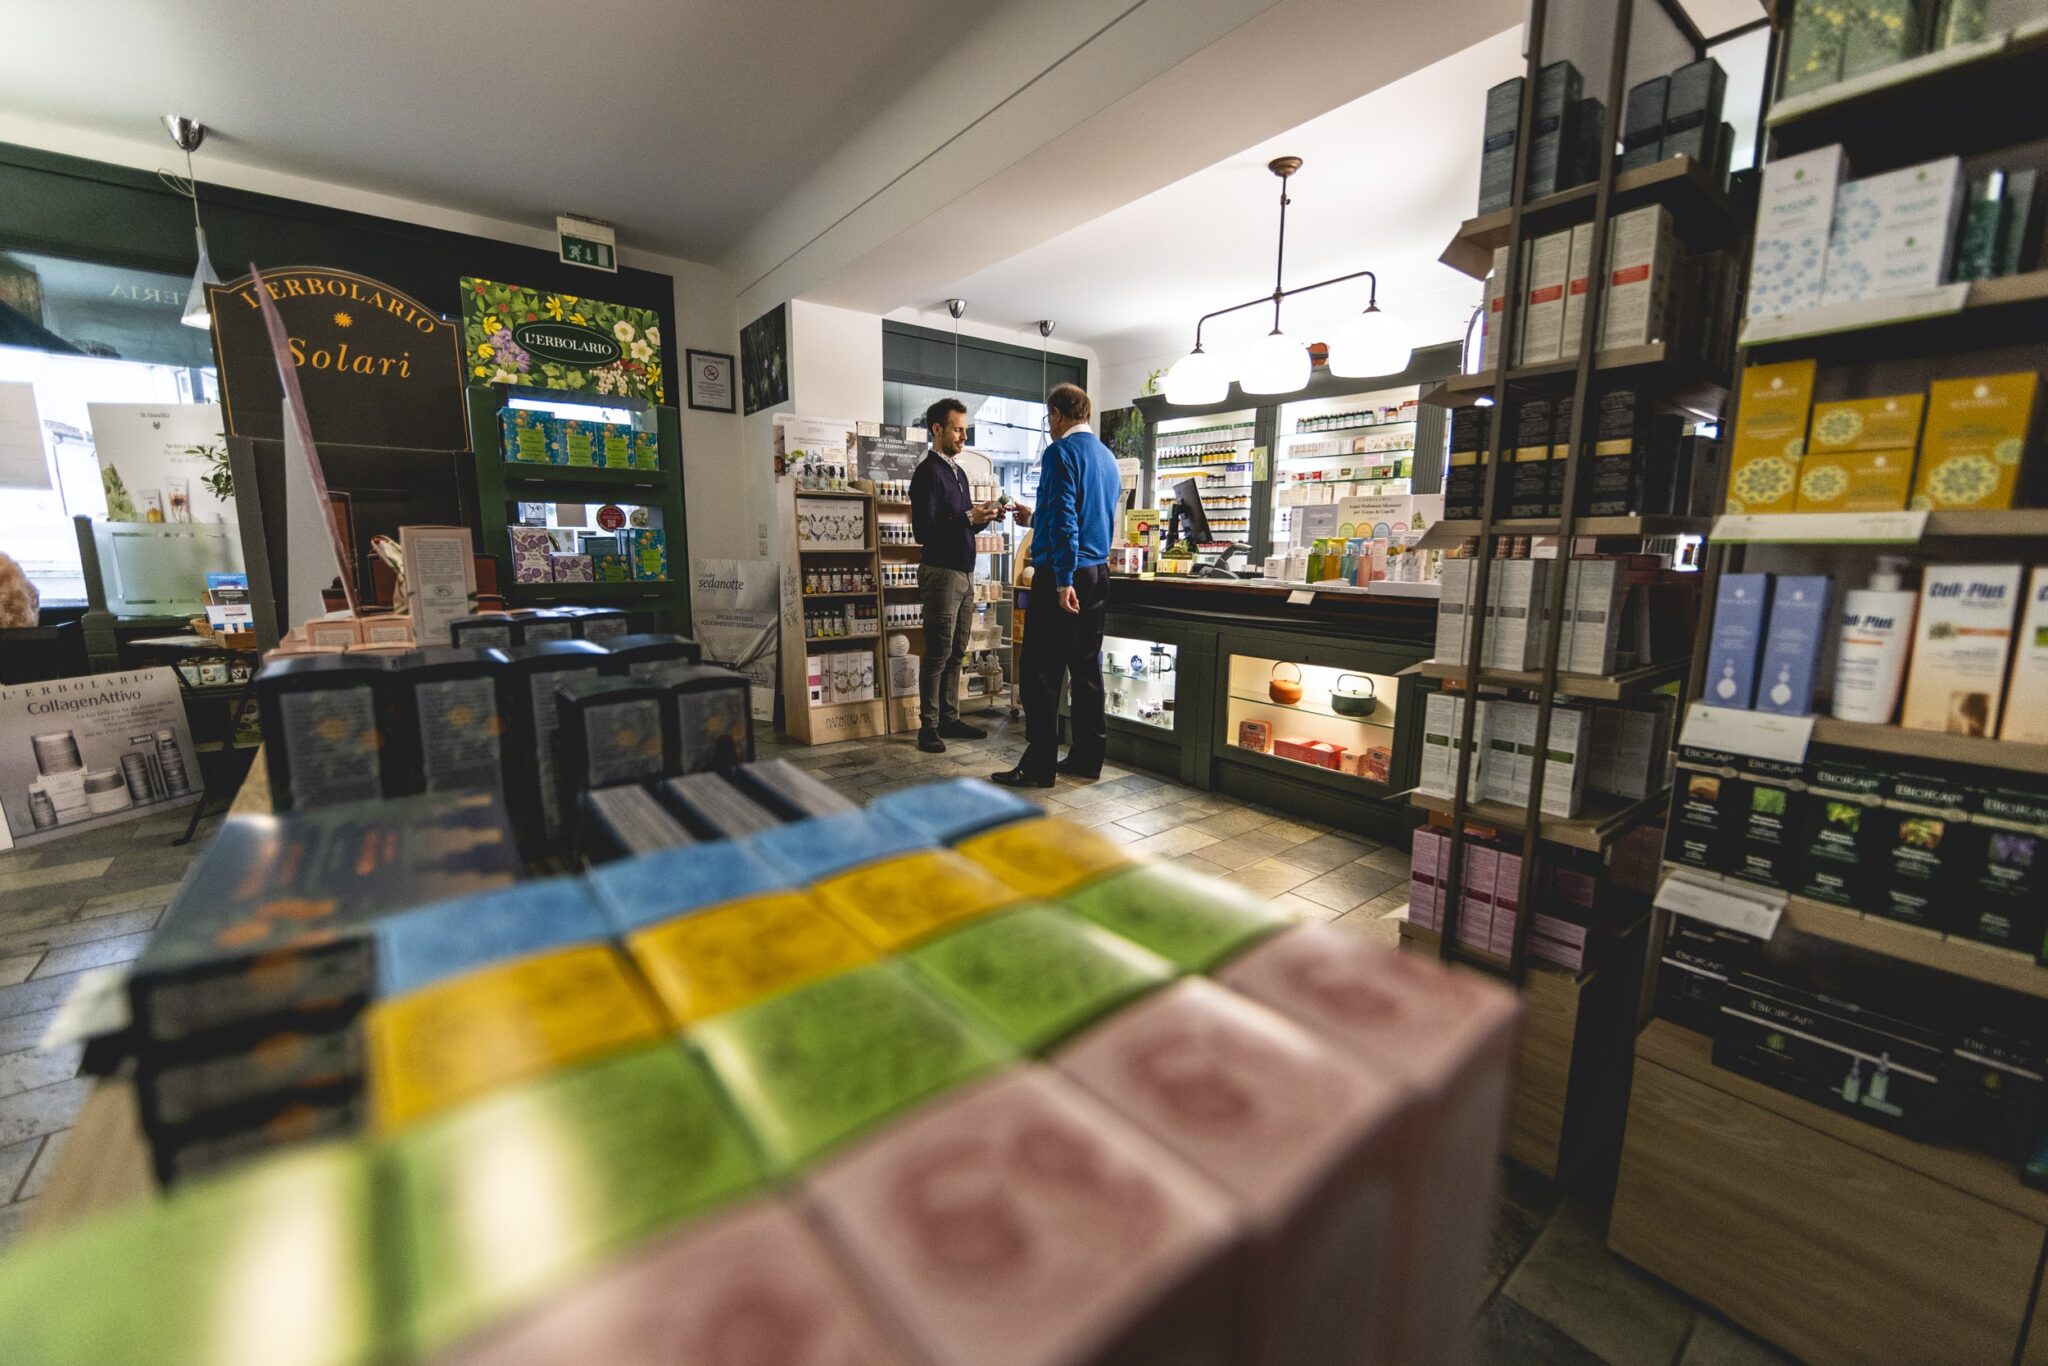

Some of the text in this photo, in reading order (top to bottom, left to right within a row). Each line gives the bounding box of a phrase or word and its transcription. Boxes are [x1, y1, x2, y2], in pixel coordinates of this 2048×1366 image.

[525, 332, 612, 355] L'ERBOLARIO
[287, 336, 411, 378] Solari
[698, 577, 744, 590] sedanotte
[2, 673, 154, 701] L'ERBOLARIO
[27, 689, 142, 715] CollagenAttivo
